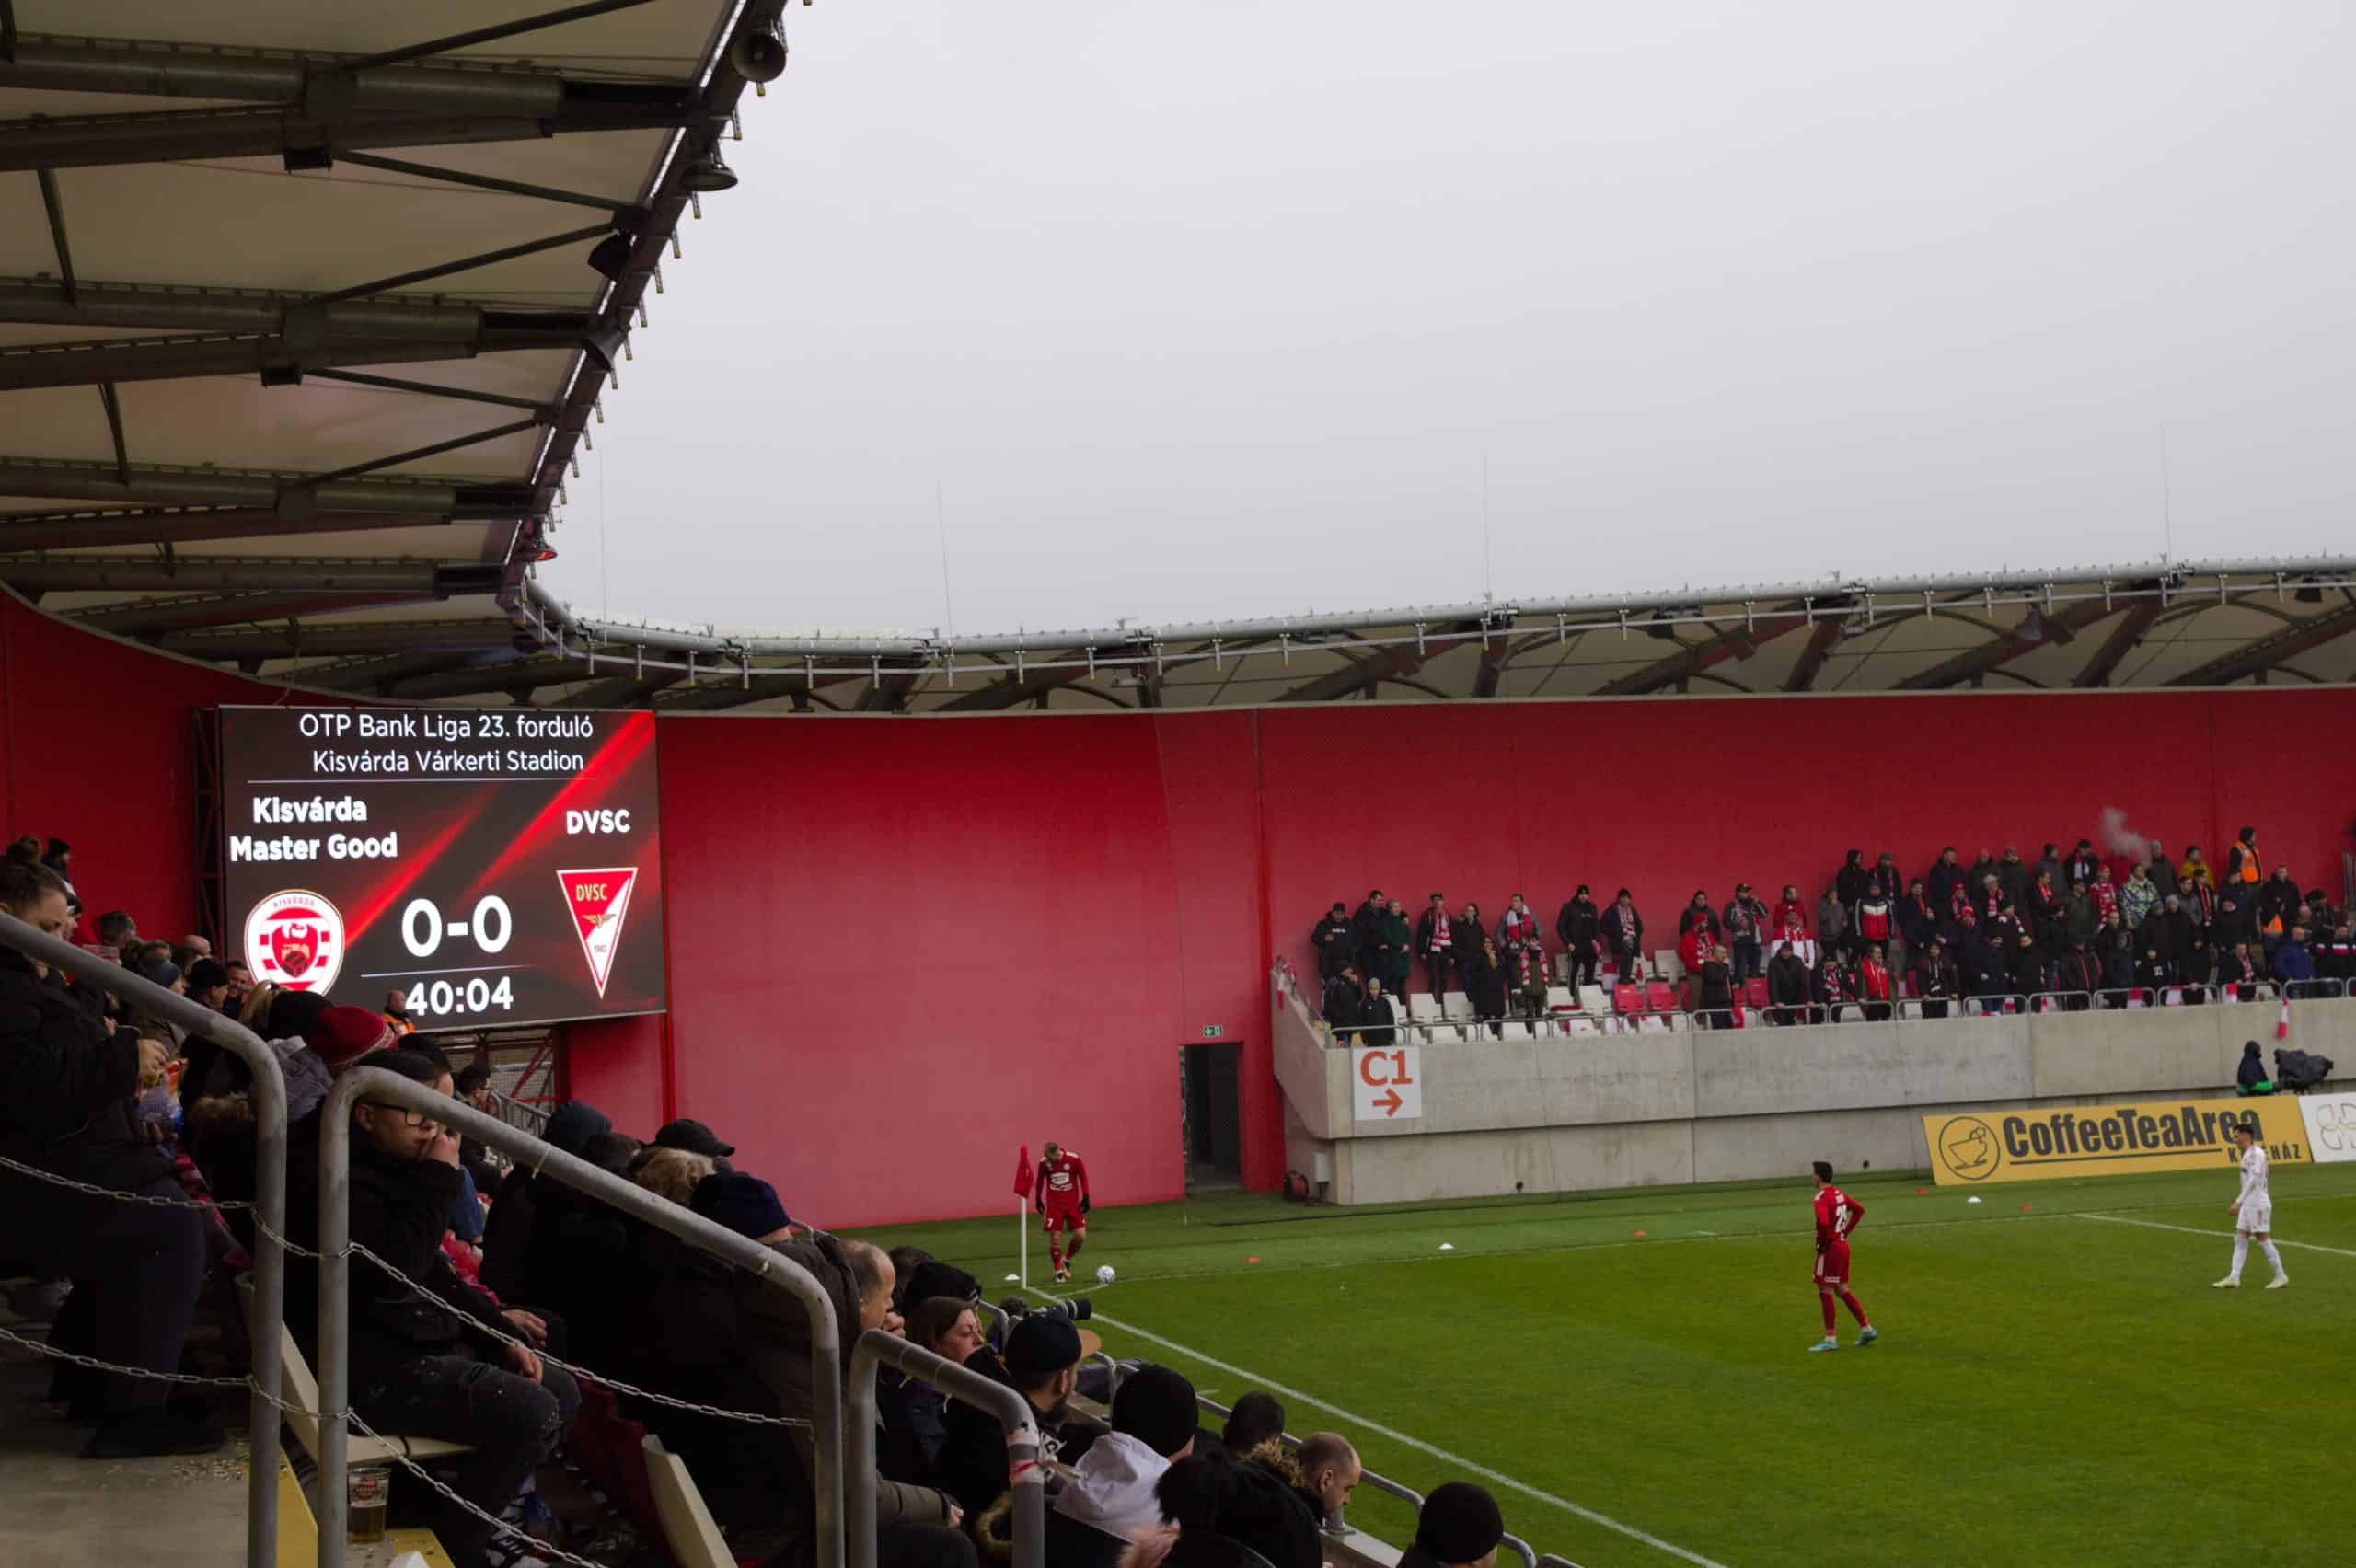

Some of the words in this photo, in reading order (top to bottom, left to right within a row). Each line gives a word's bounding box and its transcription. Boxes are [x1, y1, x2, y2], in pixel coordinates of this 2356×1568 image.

[299, 713, 352, 737] OTP
[359, 713, 416, 737] Bank
[423, 714, 471, 742] Liga
[478, 714, 510, 737] 23.
[516, 714, 594, 737] forduló
[313, 749, 409, 772] Kisvárda
[415, 748, 500, 772] Várkerti
[507, 748, 583, 771] Stadion
[252, 795, 367, 823] Kisvárda
[566, 809, 631, 835] DVSC
[229, 836, 320, 862] Master
[327, 831, 398, 859] Good
[575, 883, 607, 902] DVSC
[405, 976, 514, 1016] 40:04
[1360, 1049, 1414, 1087] C1
[2003, 1106, 2263, 1158] CoffeeTeaArea
